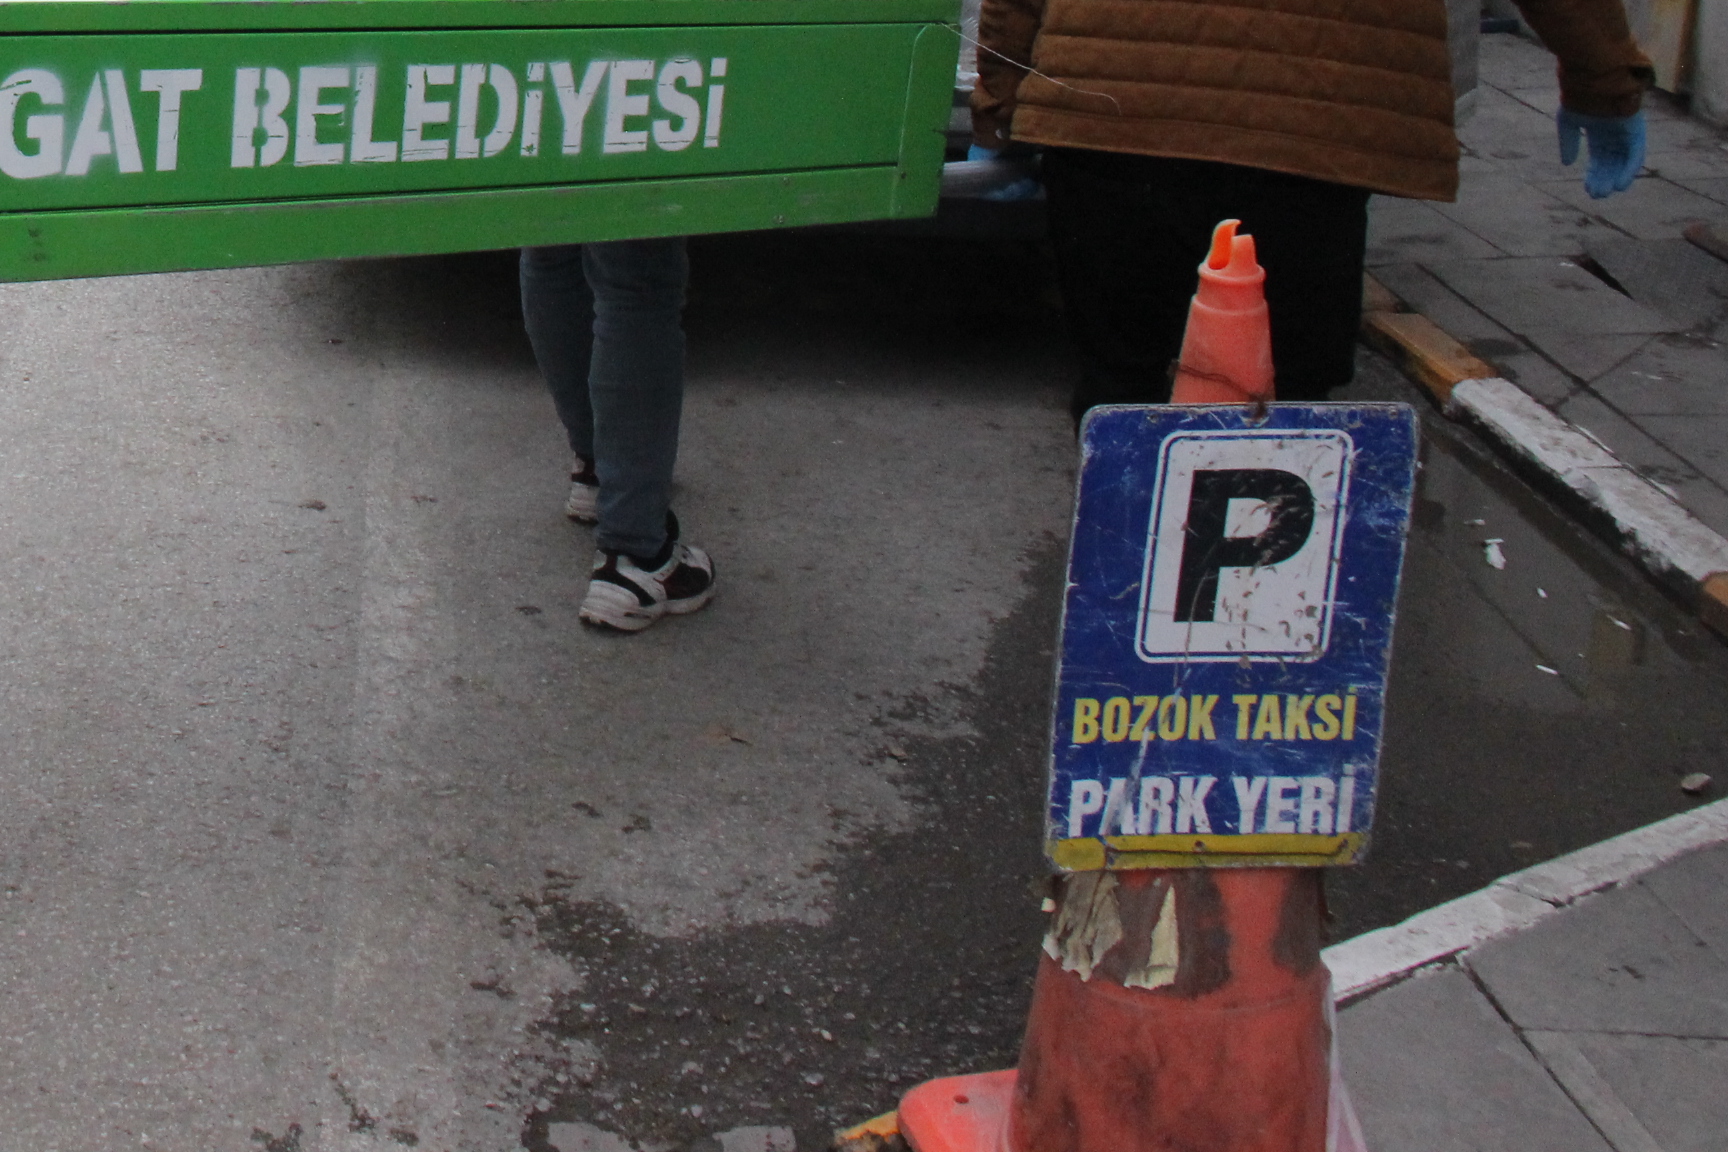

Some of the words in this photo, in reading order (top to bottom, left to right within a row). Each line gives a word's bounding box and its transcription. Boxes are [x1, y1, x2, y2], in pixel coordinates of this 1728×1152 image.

[1173, 468, 1315, 622] P
[1072, 694, 1217, 743] BOZOK
[1233, 686, 1358, 741] TAKSİ
[1069, 775, 1218, 837] PARK
[1231, 764, 1355, 835] YERİ
